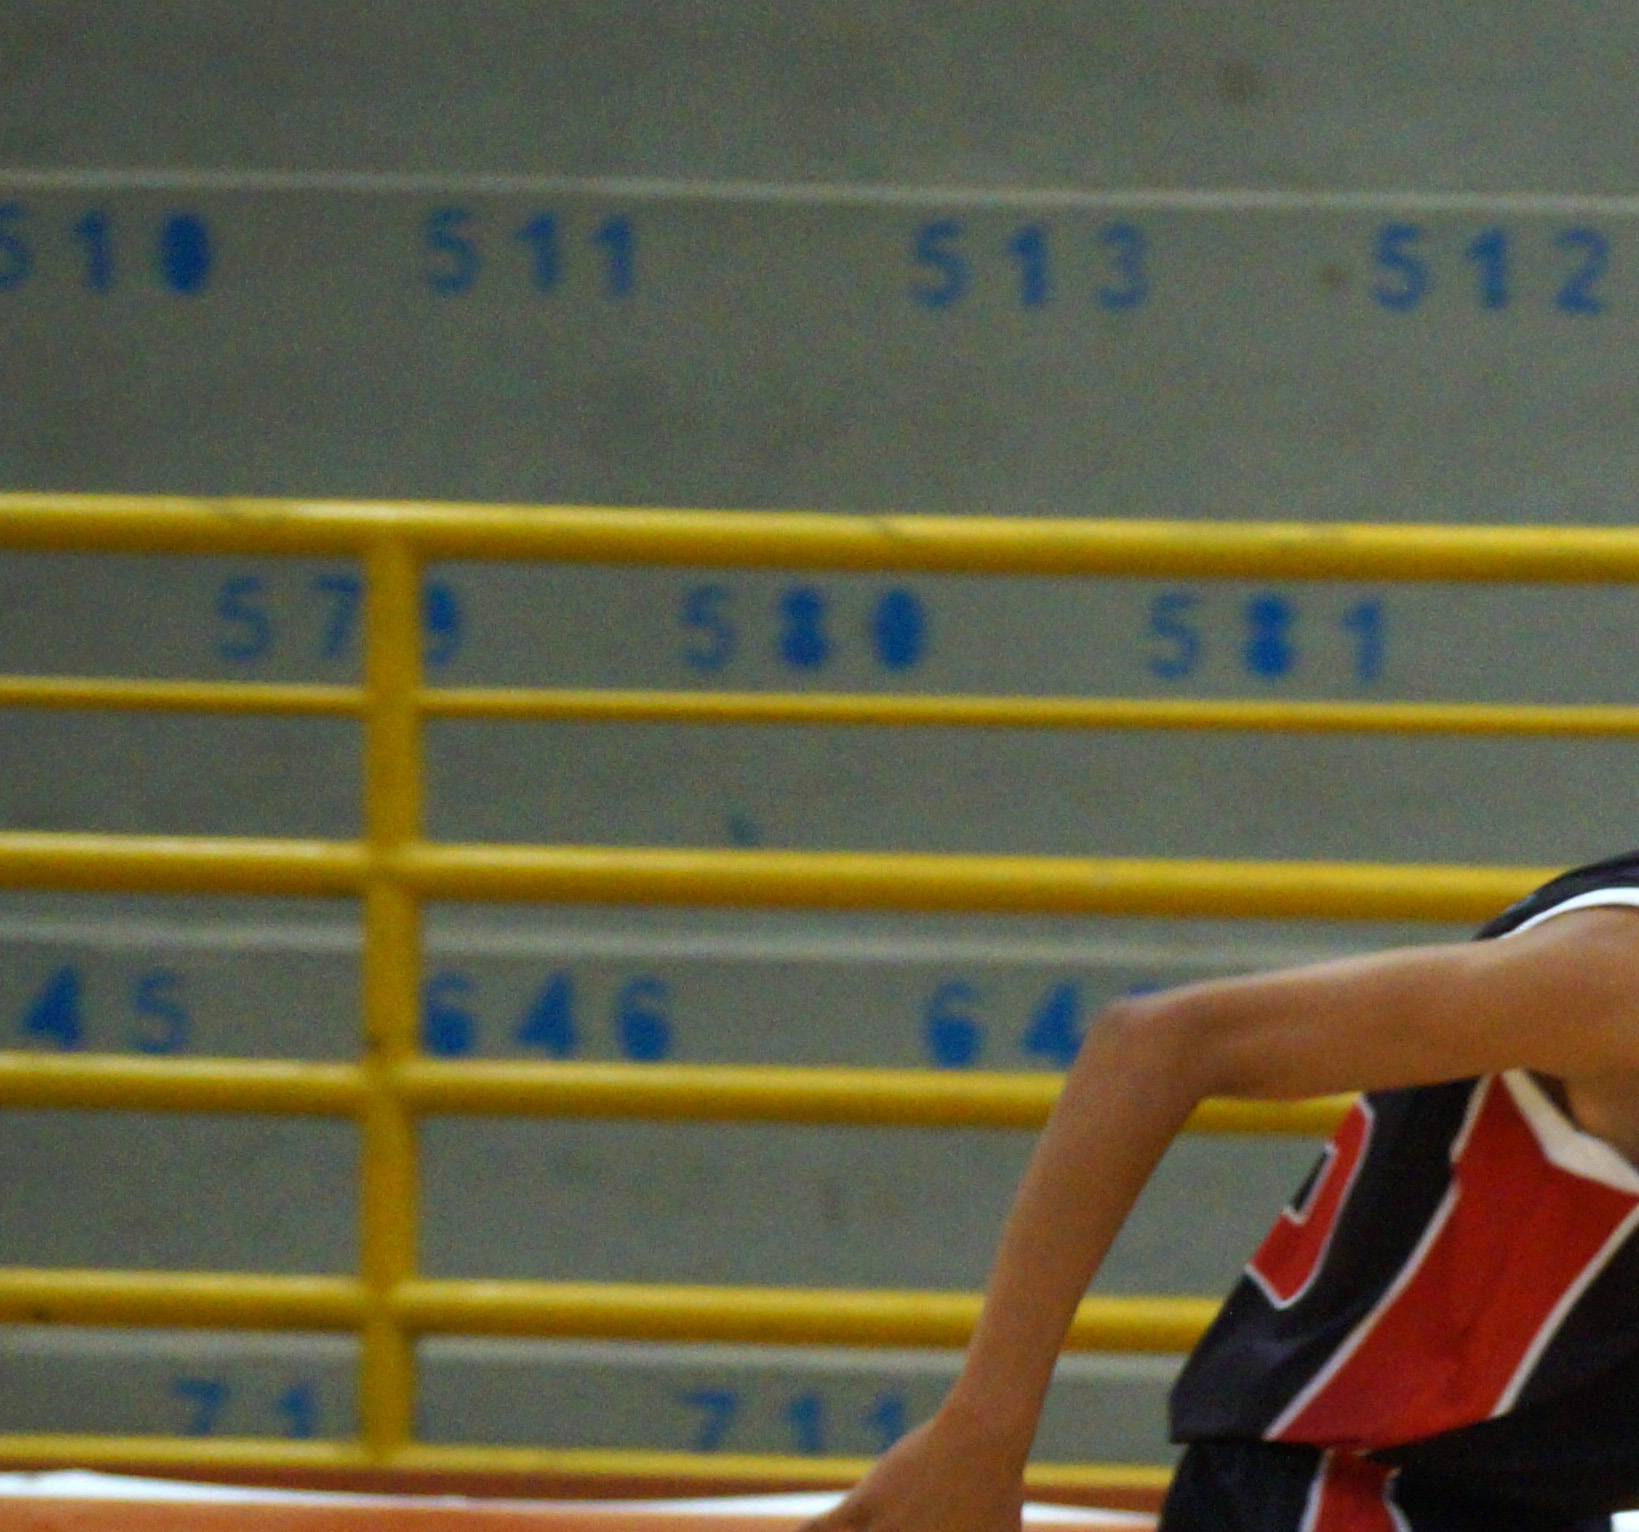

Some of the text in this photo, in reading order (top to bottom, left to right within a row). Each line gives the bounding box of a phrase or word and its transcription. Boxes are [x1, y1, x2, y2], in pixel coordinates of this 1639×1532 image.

[425, 205, 638, 297] 511
[914, 218, 1147, 313] 513
[1372, 220, 1612, 318] 512
[680, 582, 933, 678] 580
[1147, 590, 1390, 686] 581
[419, 971, 678, 1064] 646
